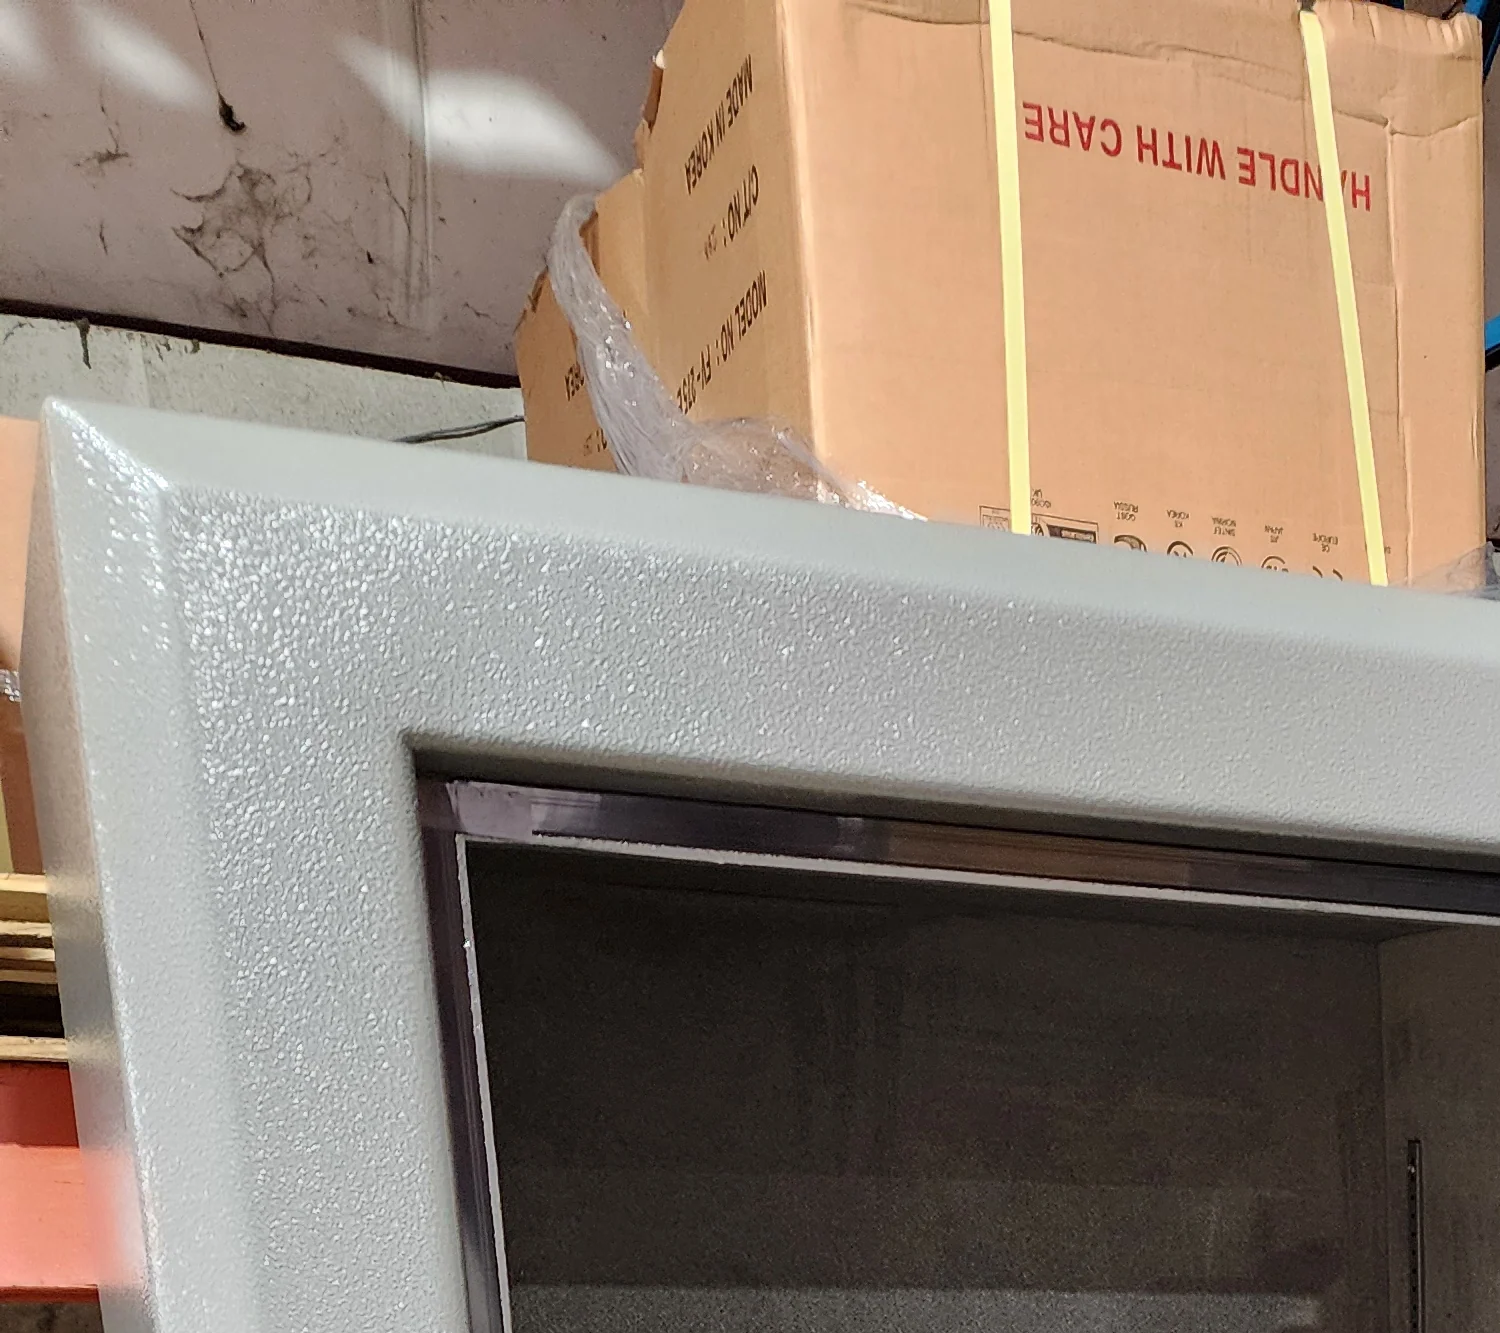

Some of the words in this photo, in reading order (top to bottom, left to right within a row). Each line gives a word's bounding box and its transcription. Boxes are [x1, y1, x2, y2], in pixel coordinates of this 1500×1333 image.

[715, 99, 726, 147] IN
[726, 54, 753, 128] MADE
[684, 118, 715, 195] KOREA
[1022, 100, 1122, 157] CARE
[1136, 124, 1226, 180] WITH
[1237, 146, 1371, 212] HNDLE
[735, 269, 767, 341] MODEL
